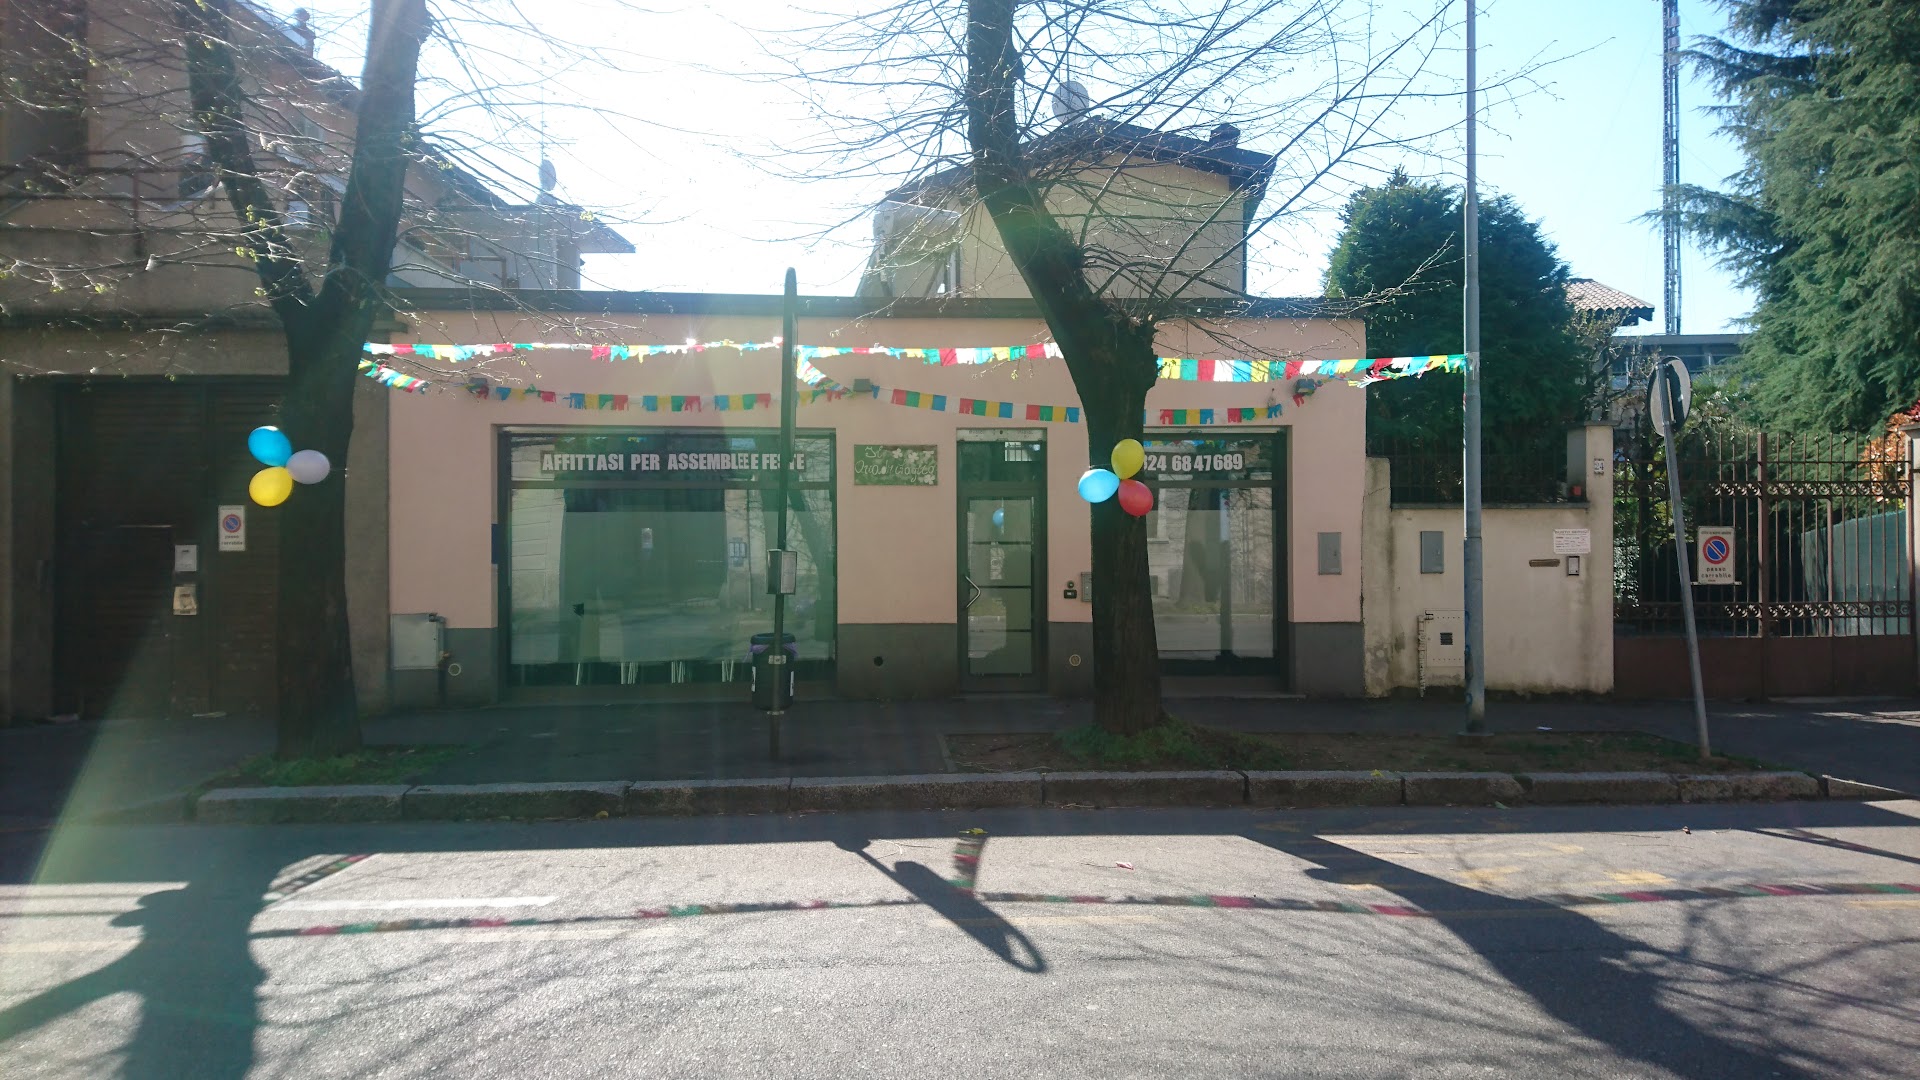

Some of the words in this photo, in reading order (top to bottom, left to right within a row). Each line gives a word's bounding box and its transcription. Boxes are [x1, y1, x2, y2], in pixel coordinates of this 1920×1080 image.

[542, 453, 624, 471] AFFITTASI
[630, 453, 660, 471] PER
[667, 453, 750, 470] ASSEMBLEE
